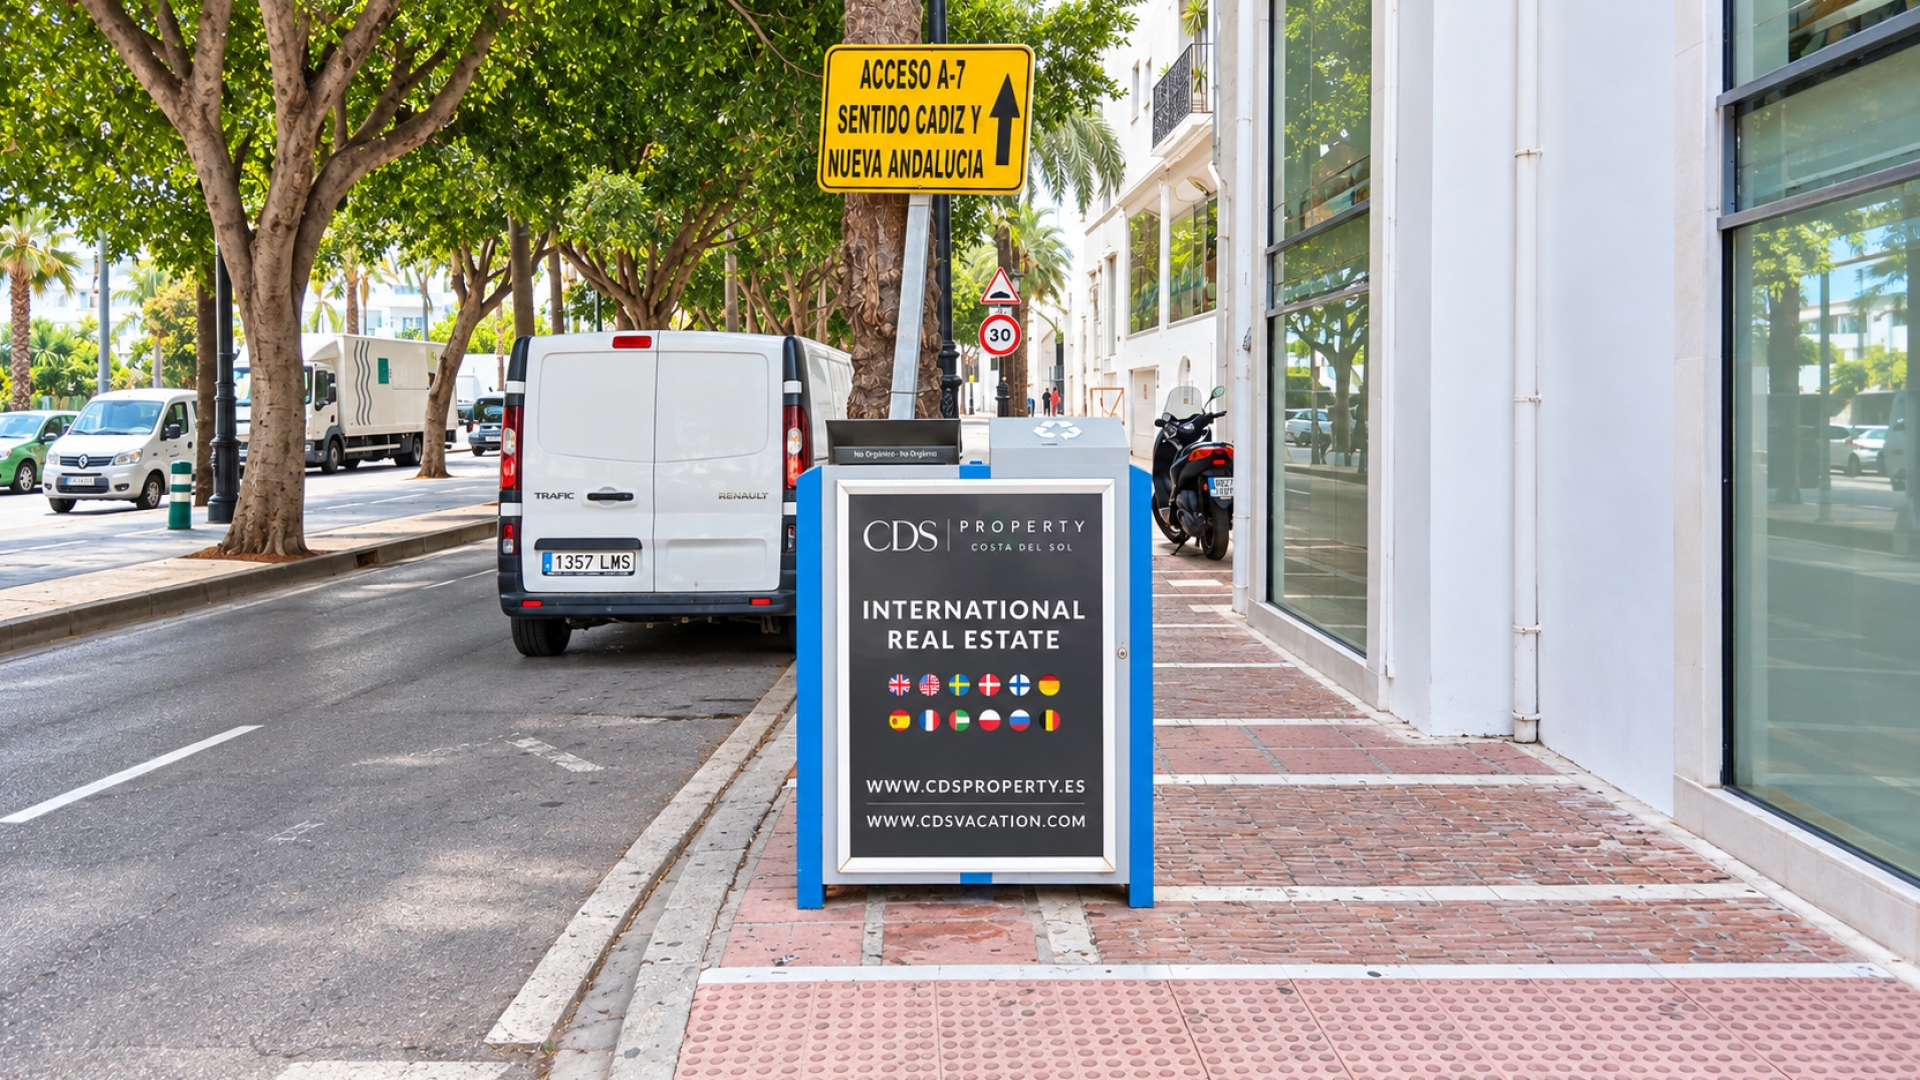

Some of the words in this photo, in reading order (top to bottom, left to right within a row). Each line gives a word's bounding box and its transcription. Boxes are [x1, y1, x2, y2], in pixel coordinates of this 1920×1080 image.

[860, 59, 931, 90] ACCESO
[937, 59, 966, 90] A-7
[838, 104, 910, 134] SENTIDO
[915, 104, 965, 134] CADIZ
[971, 104, 982, 134] Y
[828, 149, 882, 178] NUEVA
[887, 149, 984, 178] ANDALUCIA
[989, 328, 1011, 342] 30
[534, 491, 575, 500] TRAFIC
[718, 491, 769, 500] RENAULT
[959, 519, 1086, 533] PROPERTY
[863, 519, 938, 552] CDS
[971, 542, 1012, 552] COSTA
[1018, 542, 1042, 552] DEL
[1049, 542, 1073, 552] SOL
[555, 554, 594, 570] 1357
[600, 554, 631, 570] LMS
[863, 599, 1085, 620] INTERNATIONAL
[888, 629, 954, 649] REAL
[964, 629, 1060, 649] ESTATE
[866, 779, 1086, 794] WWW.CDSPROPERTY.ES
[866, 814, 1087, 828] WWW.CDSVACATION.COM
